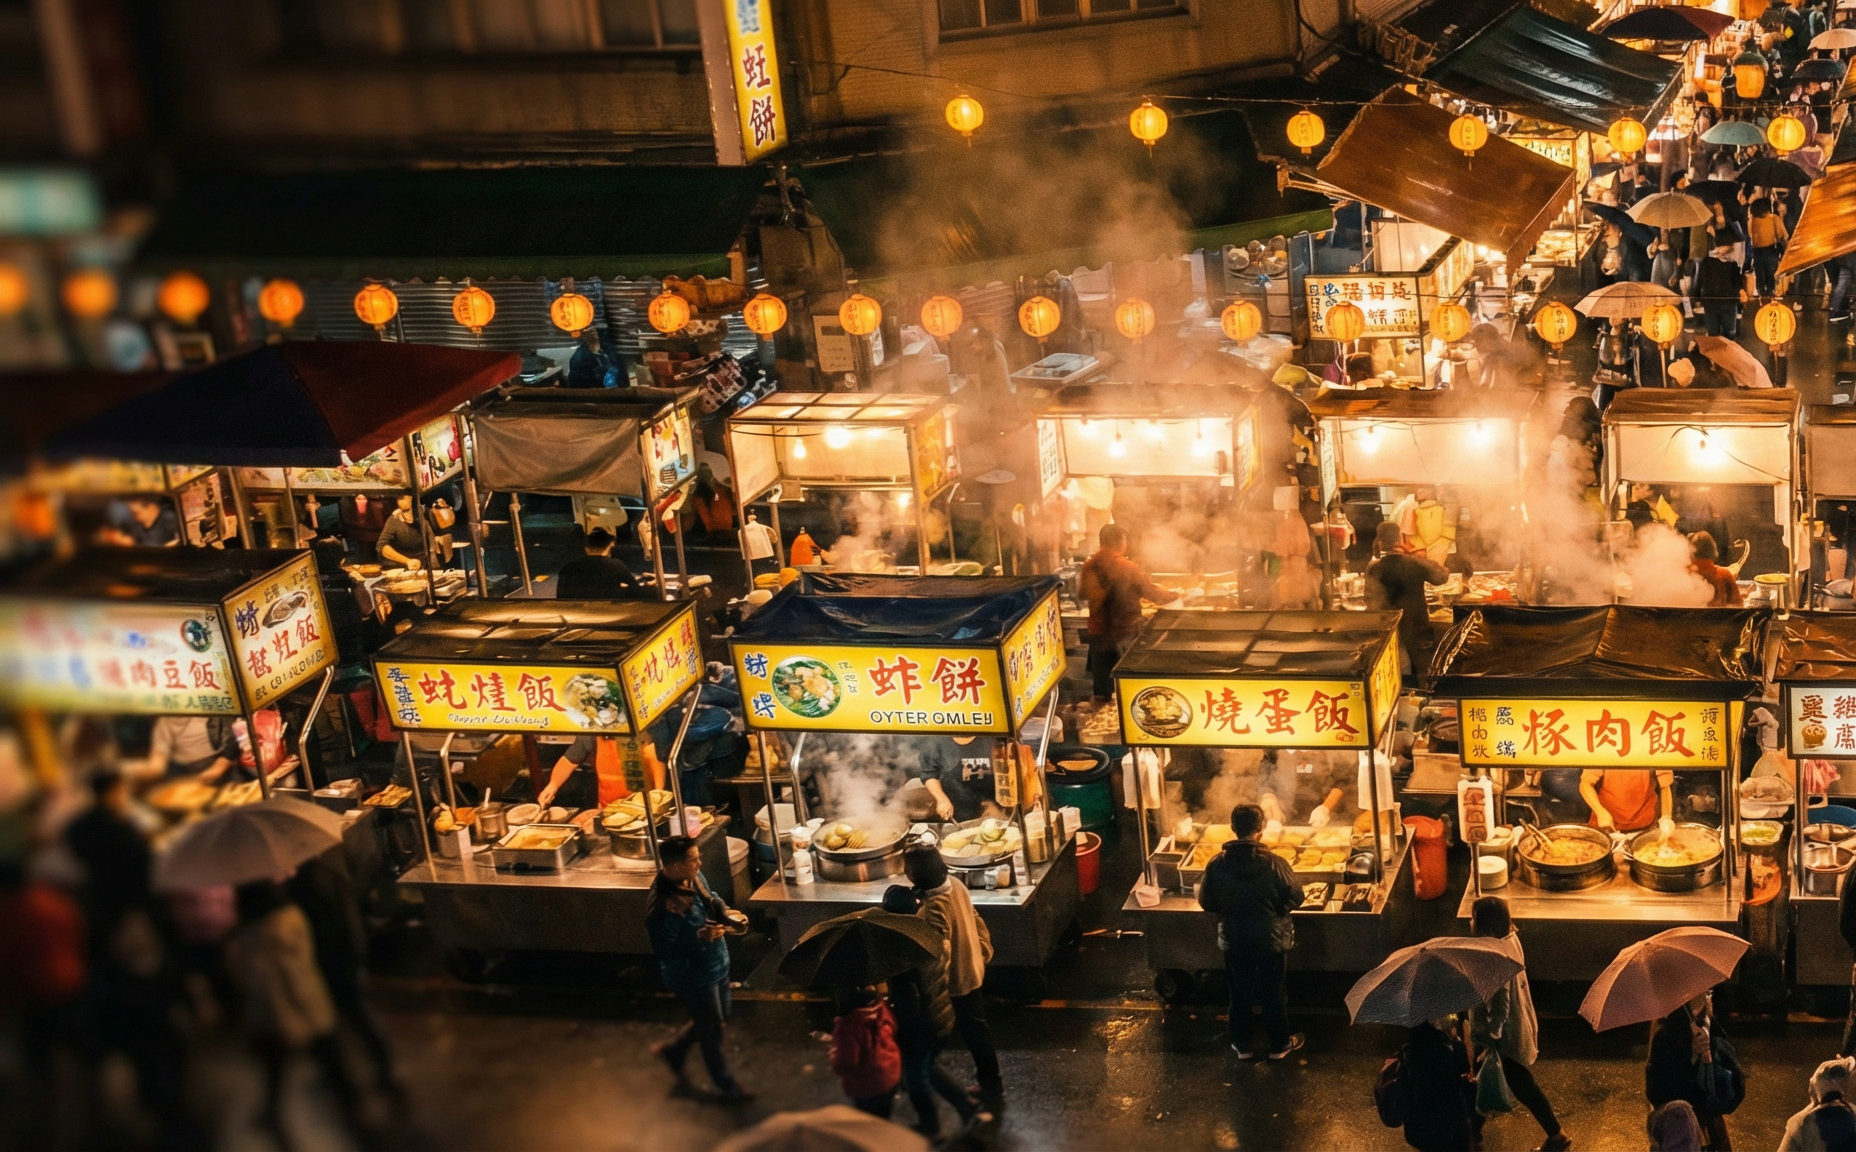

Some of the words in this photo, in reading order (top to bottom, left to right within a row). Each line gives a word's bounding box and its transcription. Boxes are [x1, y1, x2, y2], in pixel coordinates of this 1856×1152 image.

[870, 711, 928, 724] OYTER
[1200, 686, 1360, 736] 燒蛋飯
